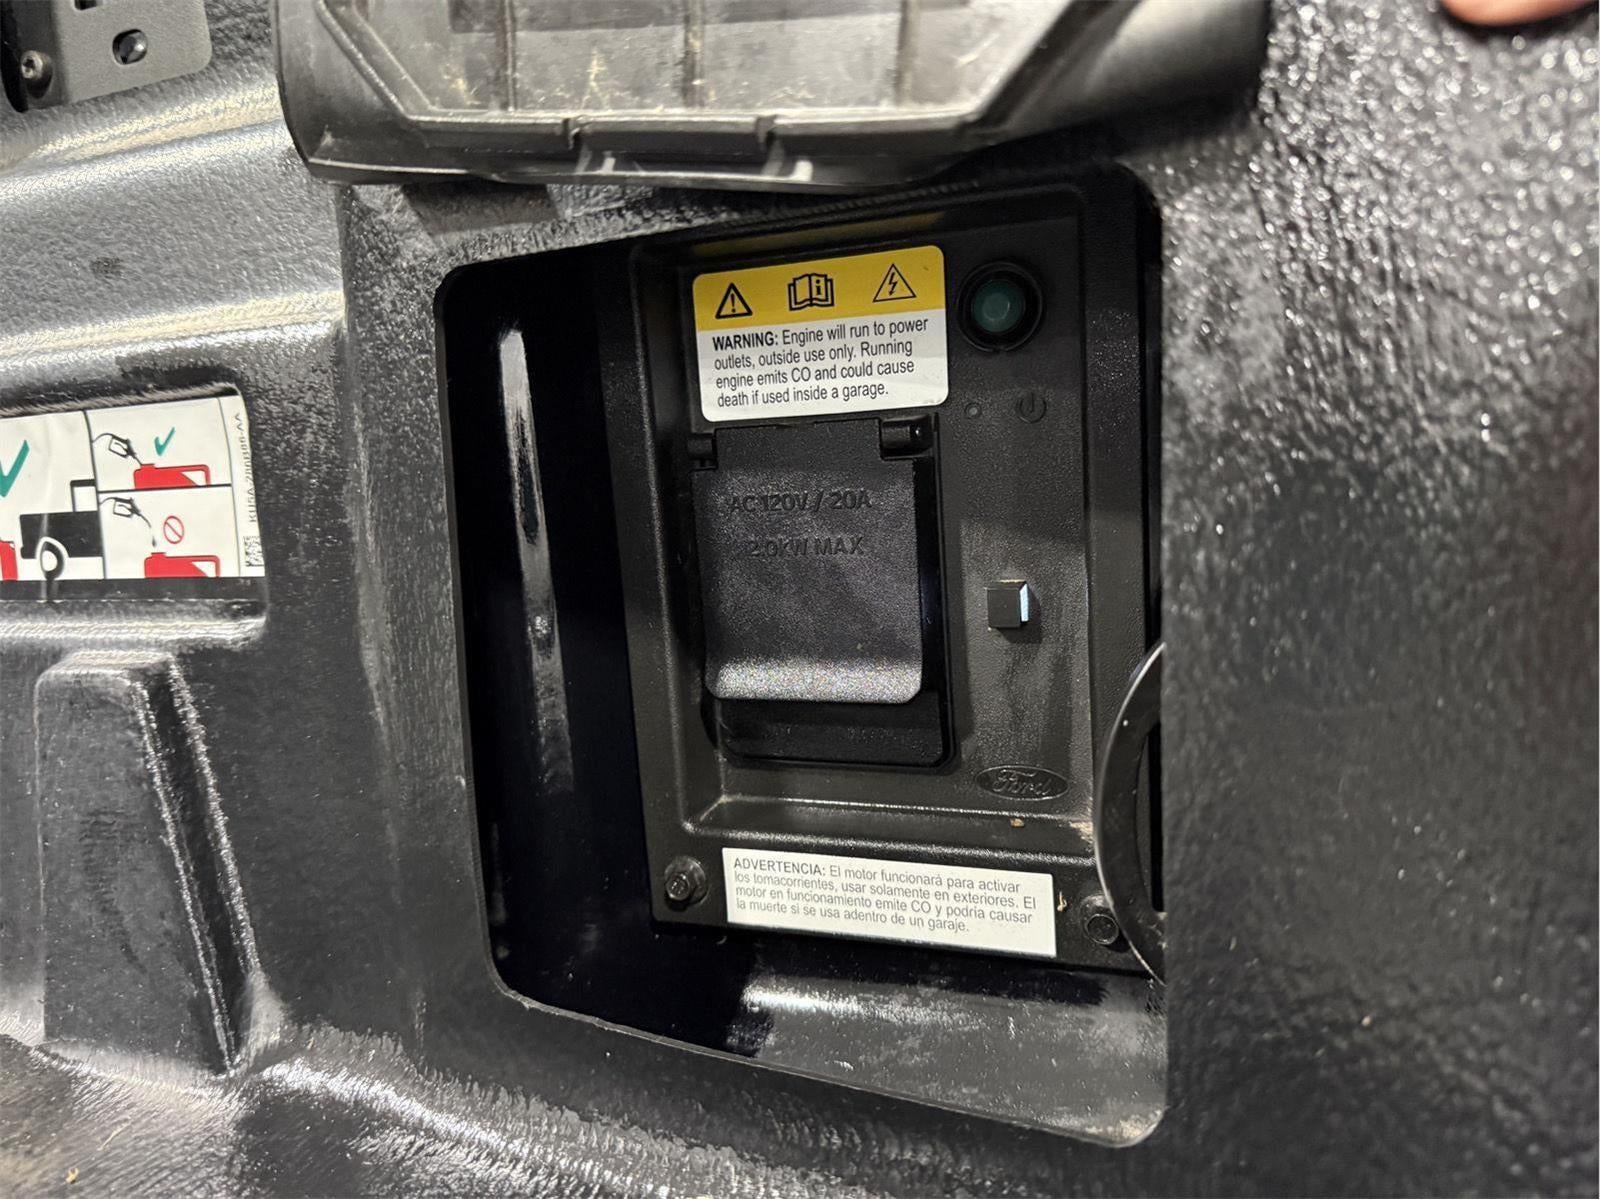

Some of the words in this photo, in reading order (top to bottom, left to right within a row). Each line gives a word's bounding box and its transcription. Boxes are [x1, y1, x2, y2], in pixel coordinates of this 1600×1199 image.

[712, 331, 778, 351] WARNING:
[783, 328, 824, 347] Engine
[827, 324, 846, 341] will
[850, 325, 870, 338] run
[873, 322, 885, 336] to
[890, 318, 928, 339] power
[715, 350, 755, 371] outlets,
[758, 345, 800, 366] outside
[804, 348, 825, 363] use
[829, 342, 857, 363] only.
[861, 339, 913, 358] Running
[716, 373, 753, 392] engine
[757, 369, 788, 386] emits
[791, 367, 811, 383] CO
[815, 363, 837, 381] and
[840, 360, 873, 379] could
[877, 361, 915, 376] cause
[717, 390, 749, 408] death
[752, 389, 760, 405] if
[762, 386, 790, 405] used
[793, 383, 828, 402] inside
[832, 386, 839, 399] a
[842, 383, 889, 401] garage.
[828, 489, 872, 511] 20A
[814, 536, 864, 555] MAX
[992, 769, 1052, 796] Ford
[734, 858, 826, 876] ADVERTENCIA:
[829, 865, 841, 877] El
[844, 869, 878, 881] motor
[881, 869, 943, 886] funcionará
[947, 877, 974, 889] para
[978, 879, 1020, 893] activar
[734, 871, 750, 883] los
[753, 874, 838, 892] tomacorrientes,
[841, 882, 866, 893] usar
[870, 883, 930, 898] solamente
[934, 890, 949, 900] en
[953, 892, 1019, 908] exteriores.
[1023, 896, 1036, 909] El
[736, 886, 767, 898] motor
[770, 888, 783, 899] en
[787, 888, 872, 908] funcionamiento
[875, 899, 907, 911] emite
[911, 900, 931, 913] CO
[935, 905, 942, 917] y
[989, 910, 1033, 923] causar
[736, 897, 746, 909] la
[749, 900, 787, 914] muerte
[791, 902, 800, 914] si
[803, 905, 816, 916] se
[820, 907, 840, 918] usa
[843, 909, 887, 923] adentro
[890, 912, 905, 925] de
[909, 916, 924, 927] un
[928, 919, 970, 934] garaje.
